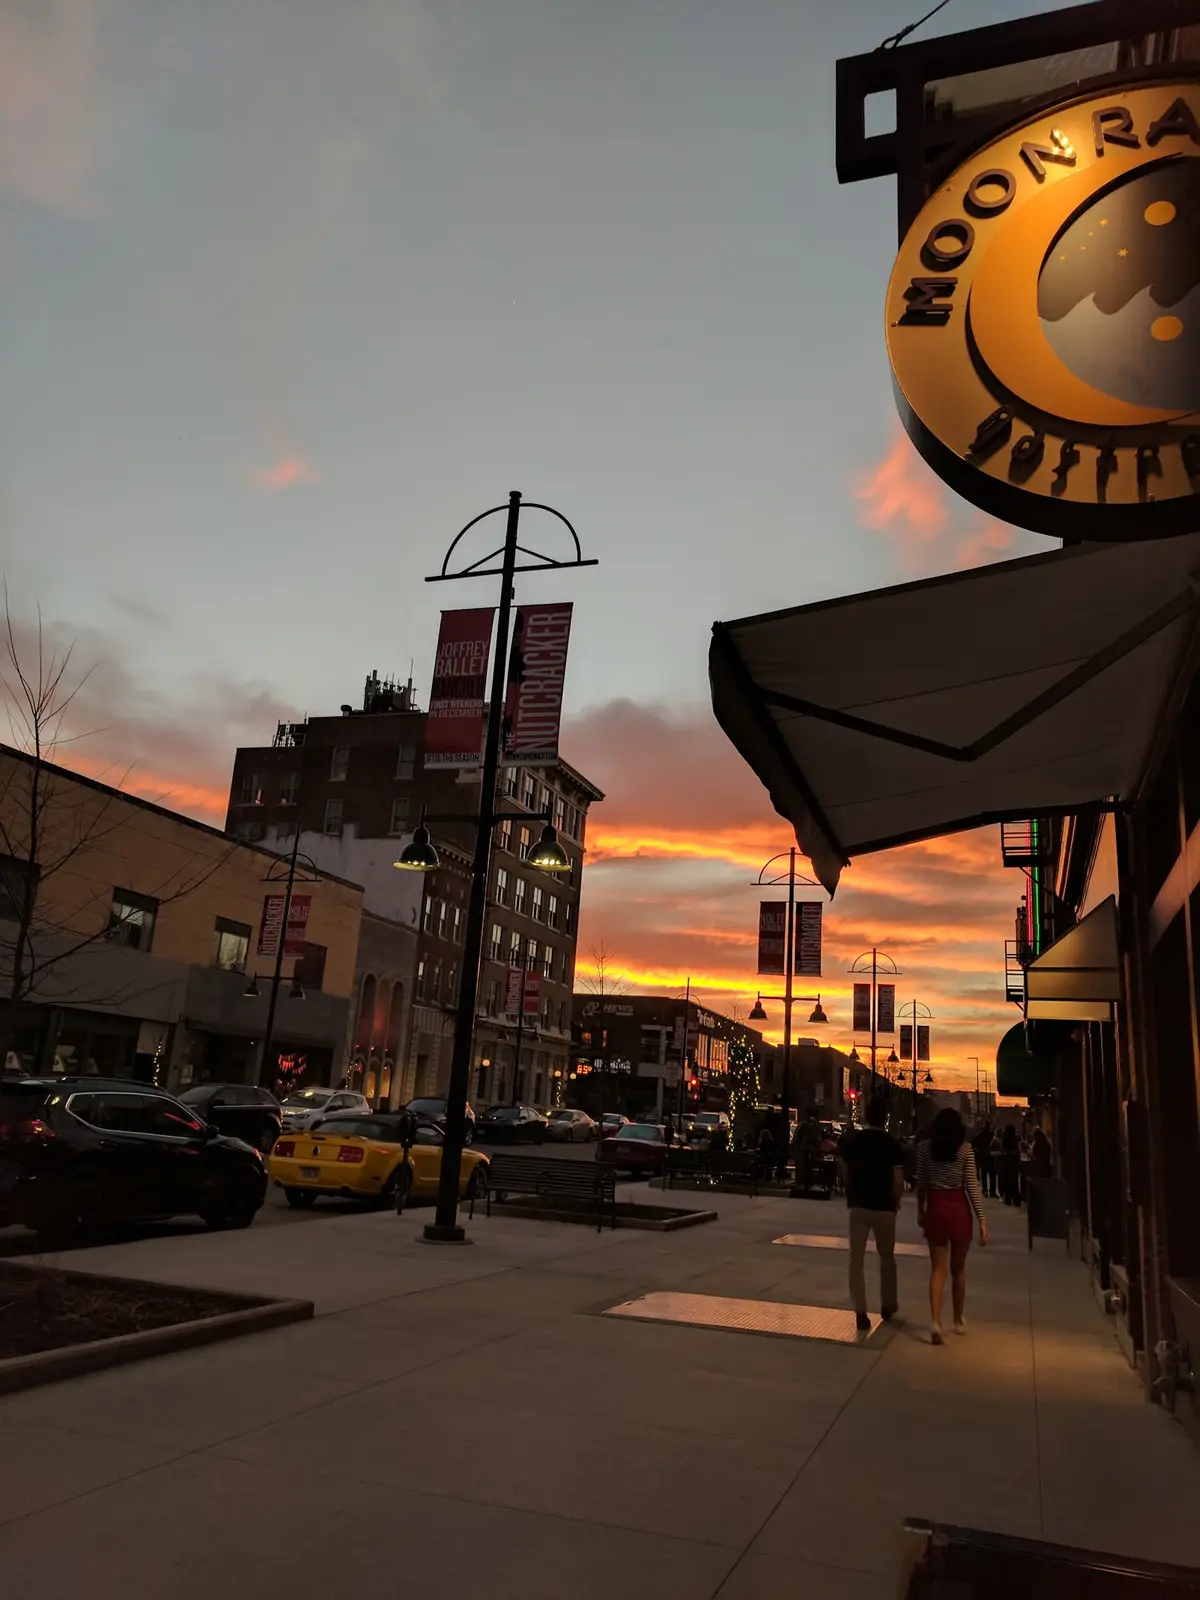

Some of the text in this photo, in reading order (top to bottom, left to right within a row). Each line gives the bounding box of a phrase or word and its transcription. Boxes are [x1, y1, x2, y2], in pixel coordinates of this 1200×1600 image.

[435, 656, 487, 677] BALLET
[437, 639, 489, 658] JOFFREY
[511, 611, 571, 751] NUTCRACKER
[261, 898, 285, 955] NUTCRACKER
[800, 905, 822, 971] NUTCRACKER
[603, 1003, 634, 1012] NEWS
